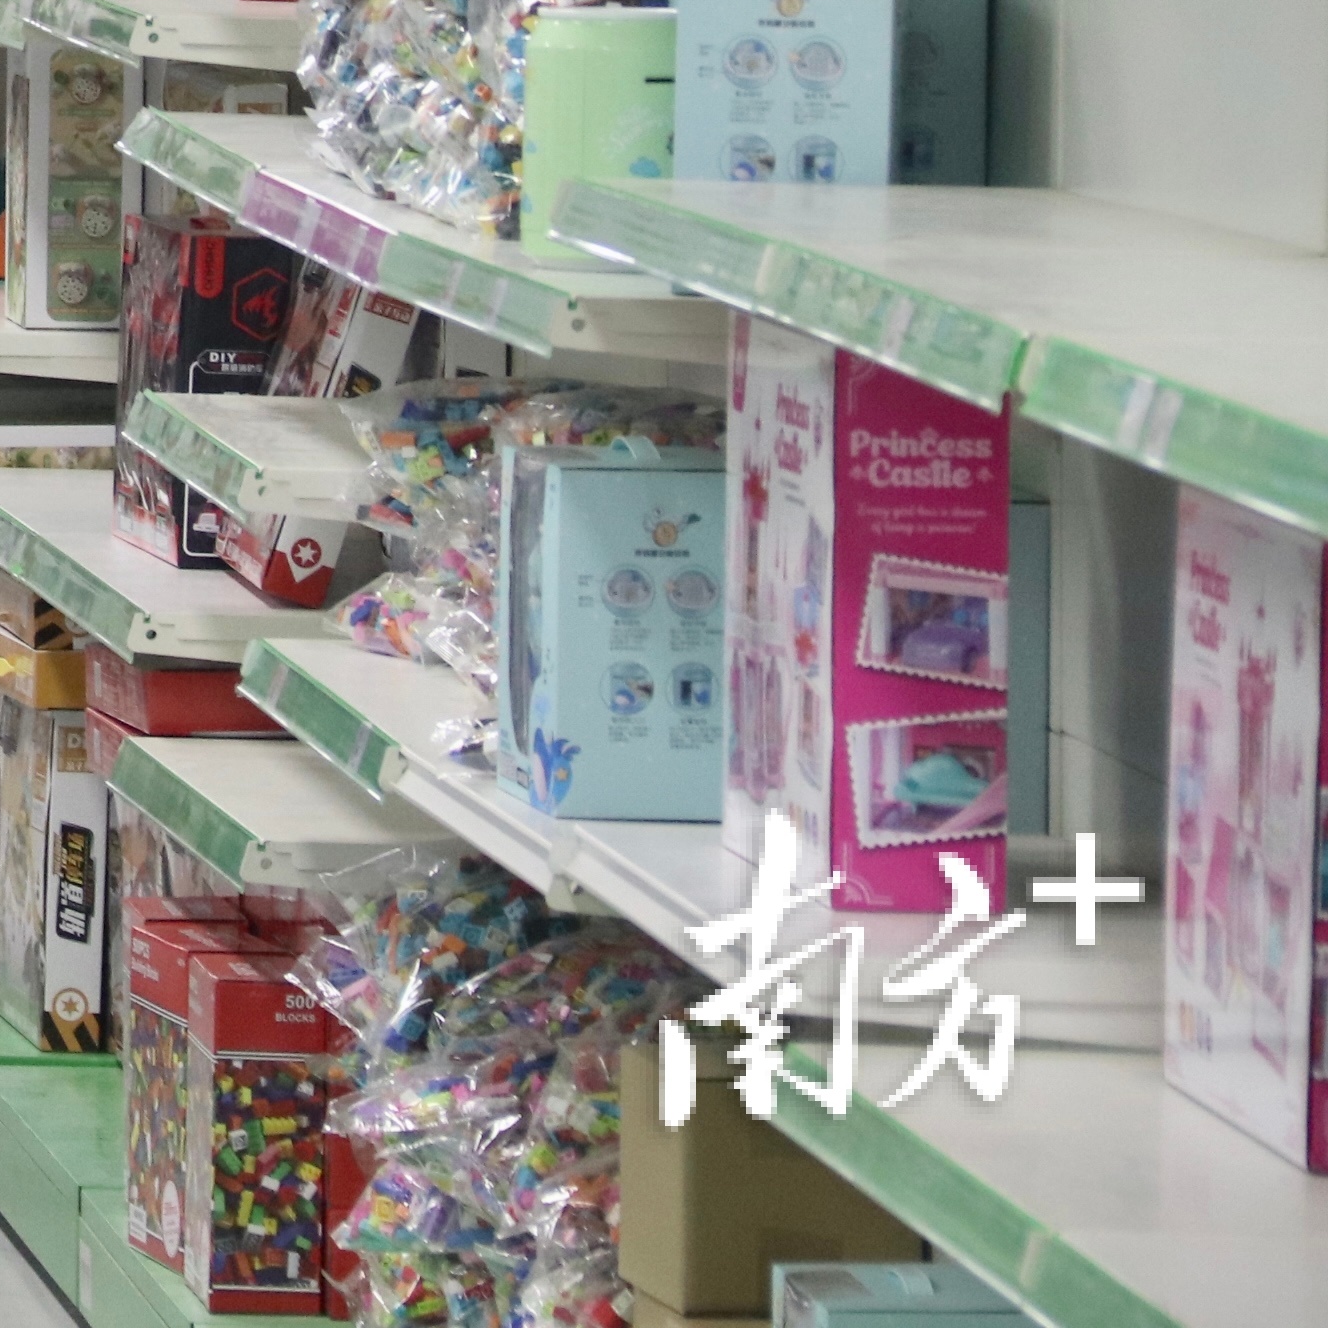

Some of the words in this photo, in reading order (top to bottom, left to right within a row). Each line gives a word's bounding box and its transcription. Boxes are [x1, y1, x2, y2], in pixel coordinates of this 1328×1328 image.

[209, 352, 237, 363] DIY
[850, 429, 993, 459] Princess
[868, 458, 972, 489] Castle
[285, 994, 316, 1010] 500
[275, 1013, 316, 1023] BLOCKS
